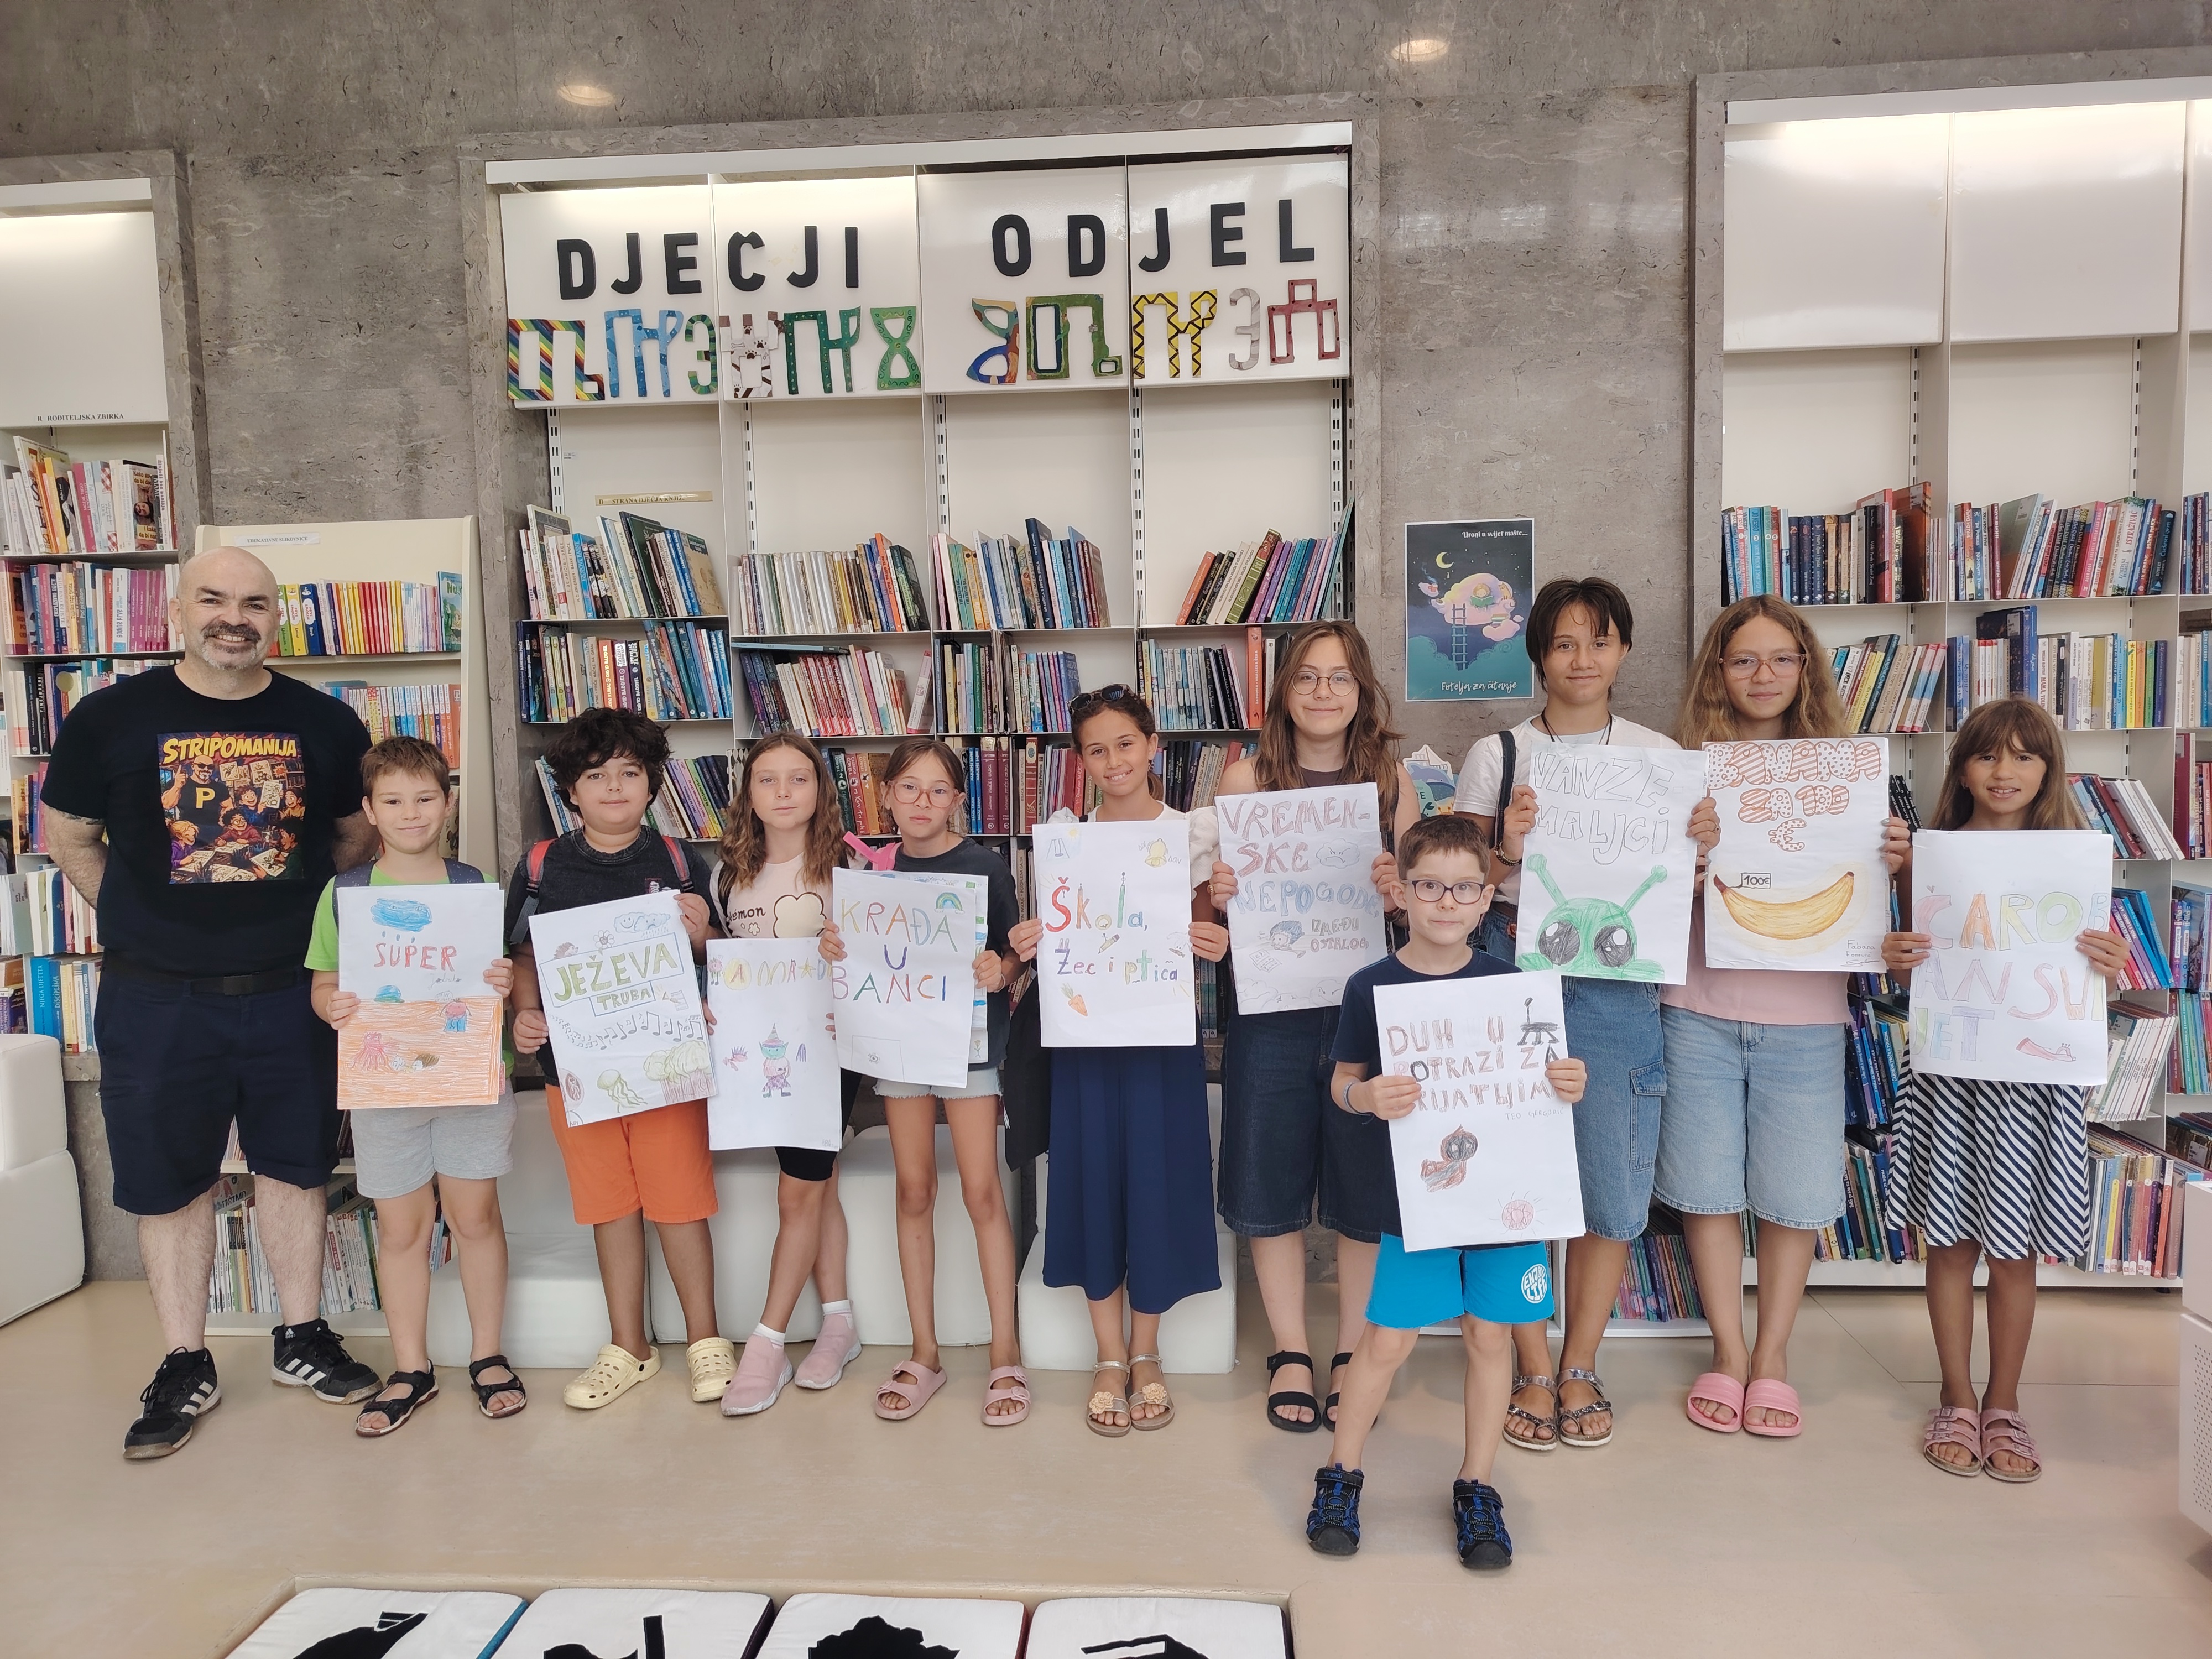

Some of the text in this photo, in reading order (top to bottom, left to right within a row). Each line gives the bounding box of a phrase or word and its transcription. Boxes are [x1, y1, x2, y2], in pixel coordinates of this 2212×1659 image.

[992, 199, 1316, 278] ODJEL
[47, 413, 96, 421] RODITELJSKA
[2125, 510, 2138, 545] ISTRAŽIVAČ
[1442, 680, 1518, 695] Fotelja za čitanje
[163, 737, 297, 764] STRIPOMANIJA
[1704, 740, 1882, 790] BANANA
[195, 787, 216, 808] P
[1738, 784, 1850, 823] ZA 100
[1220, 797, 1371, 842] VREMEN-
[1768, 818, 1807, 852] €
[1237, 841, 1312, 878] SKE
[1743, 875, 1770, 886] 100€
[840, 898, 958, 953] KRAĐA
[374, 942, 457, 972] SUPER
[884, 943, 907, 971] U
[1847, 940, 1876, 950] Fabiana
[554, 942, 679, 1002] JEŽEVA
[1108, 956, 1114, 972] i
[1914, 949, 2013, 1005] AN
[596, 988, 651, 1011] TRUBA
[831, 965, 946, 1004] BANCI
[1386, 1015, 1504, 1057] DUH U
[1911, 1006, 1995, 1062] JET
[1524, 1266, 1545, 1291] ENJOY
[1526, 1272, 1547, 1301] LIFE
